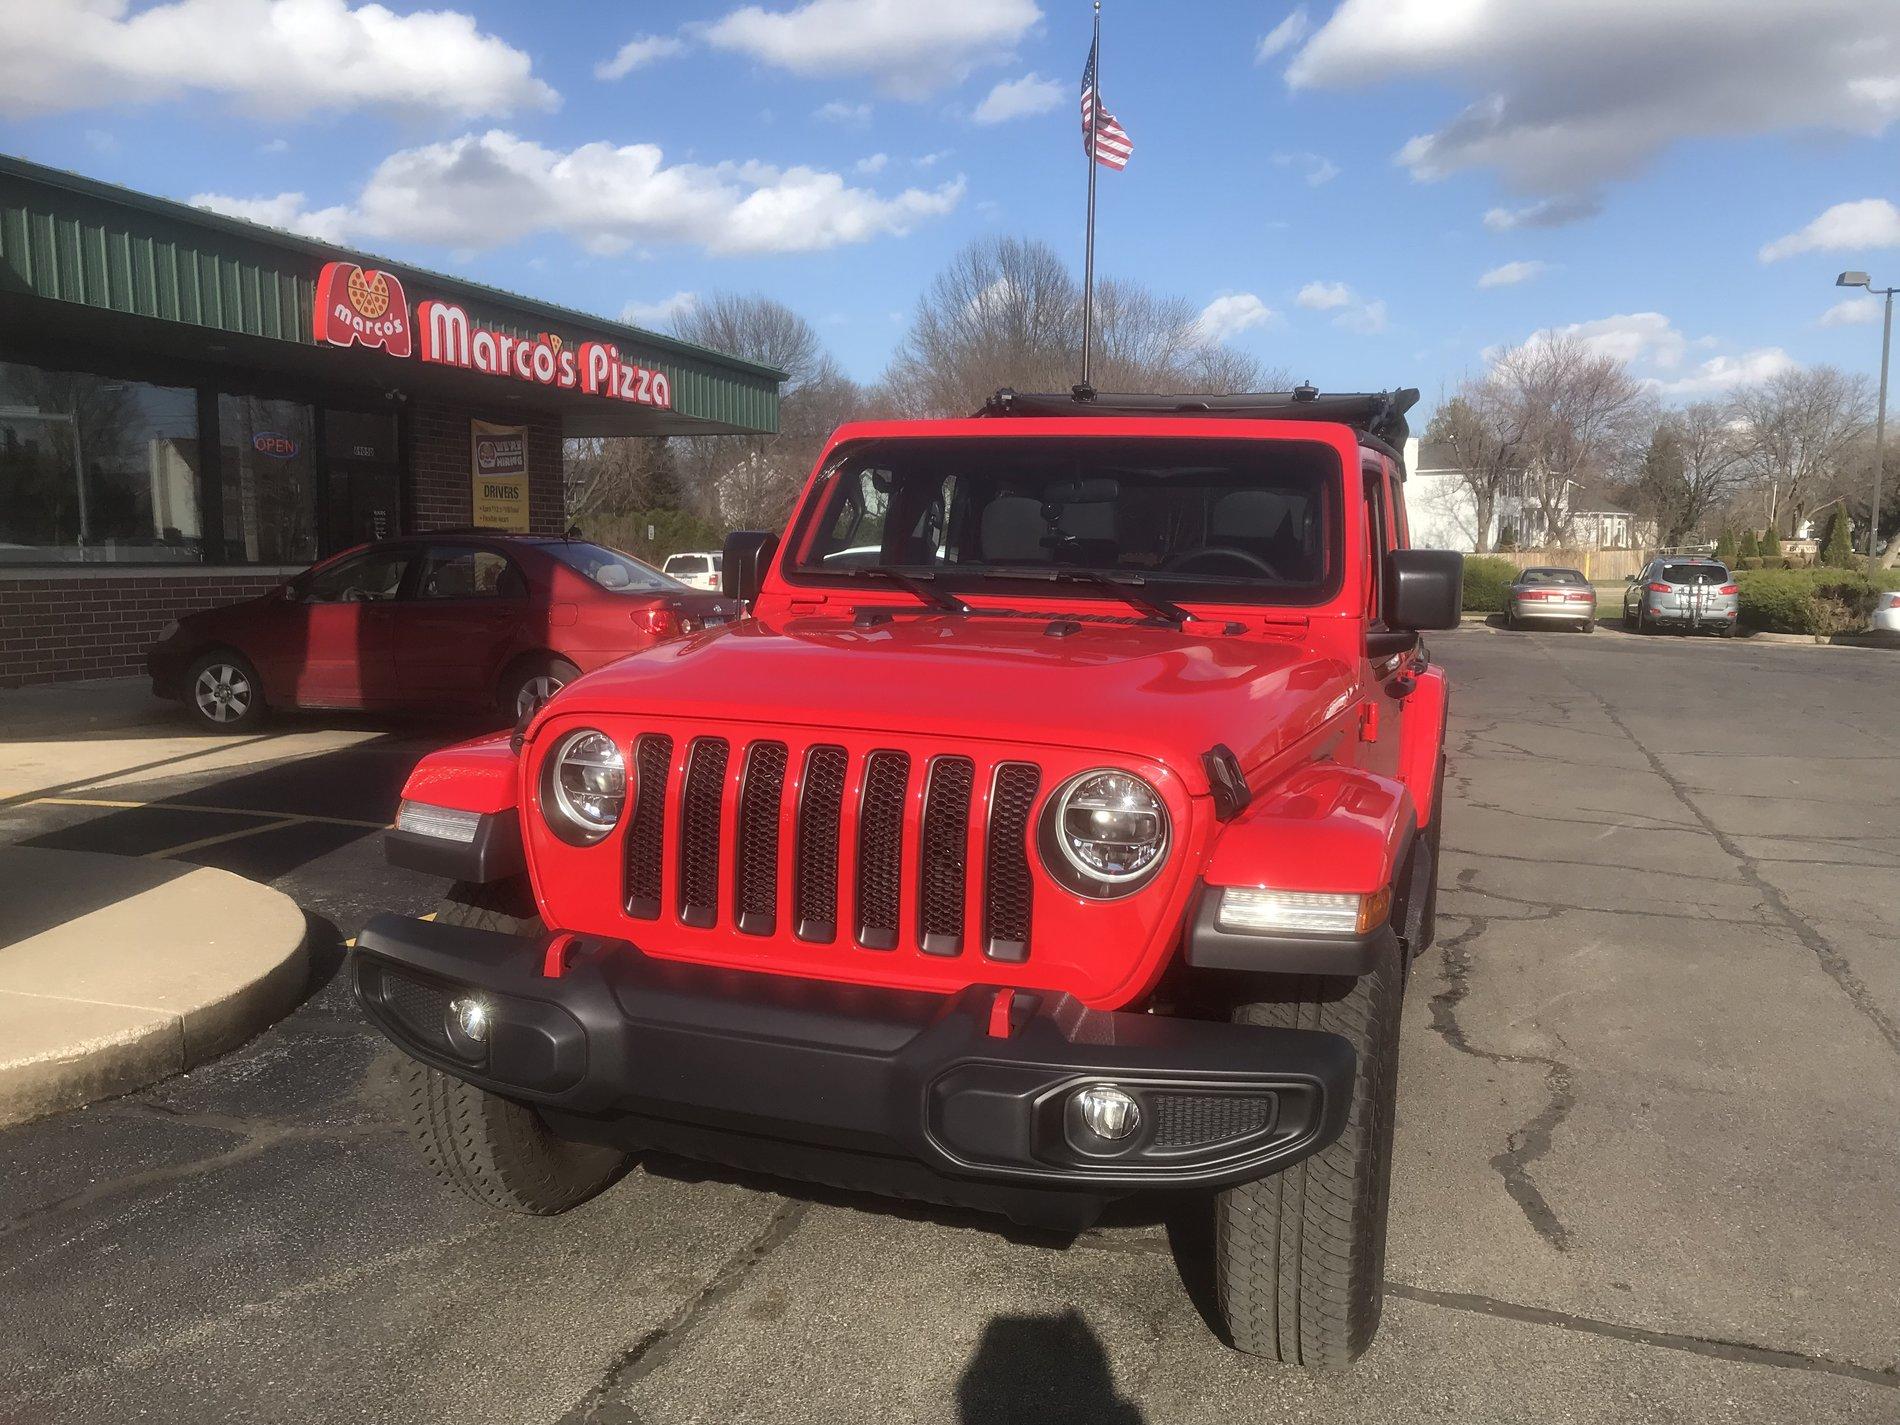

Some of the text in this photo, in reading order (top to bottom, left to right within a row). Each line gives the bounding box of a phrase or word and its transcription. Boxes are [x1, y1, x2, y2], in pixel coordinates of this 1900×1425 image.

[423, 301, 671, 409] Marco's Pizza
[256, 438, 294, 453] OPEN
[484, 485, 519, 500] DRIVERS
